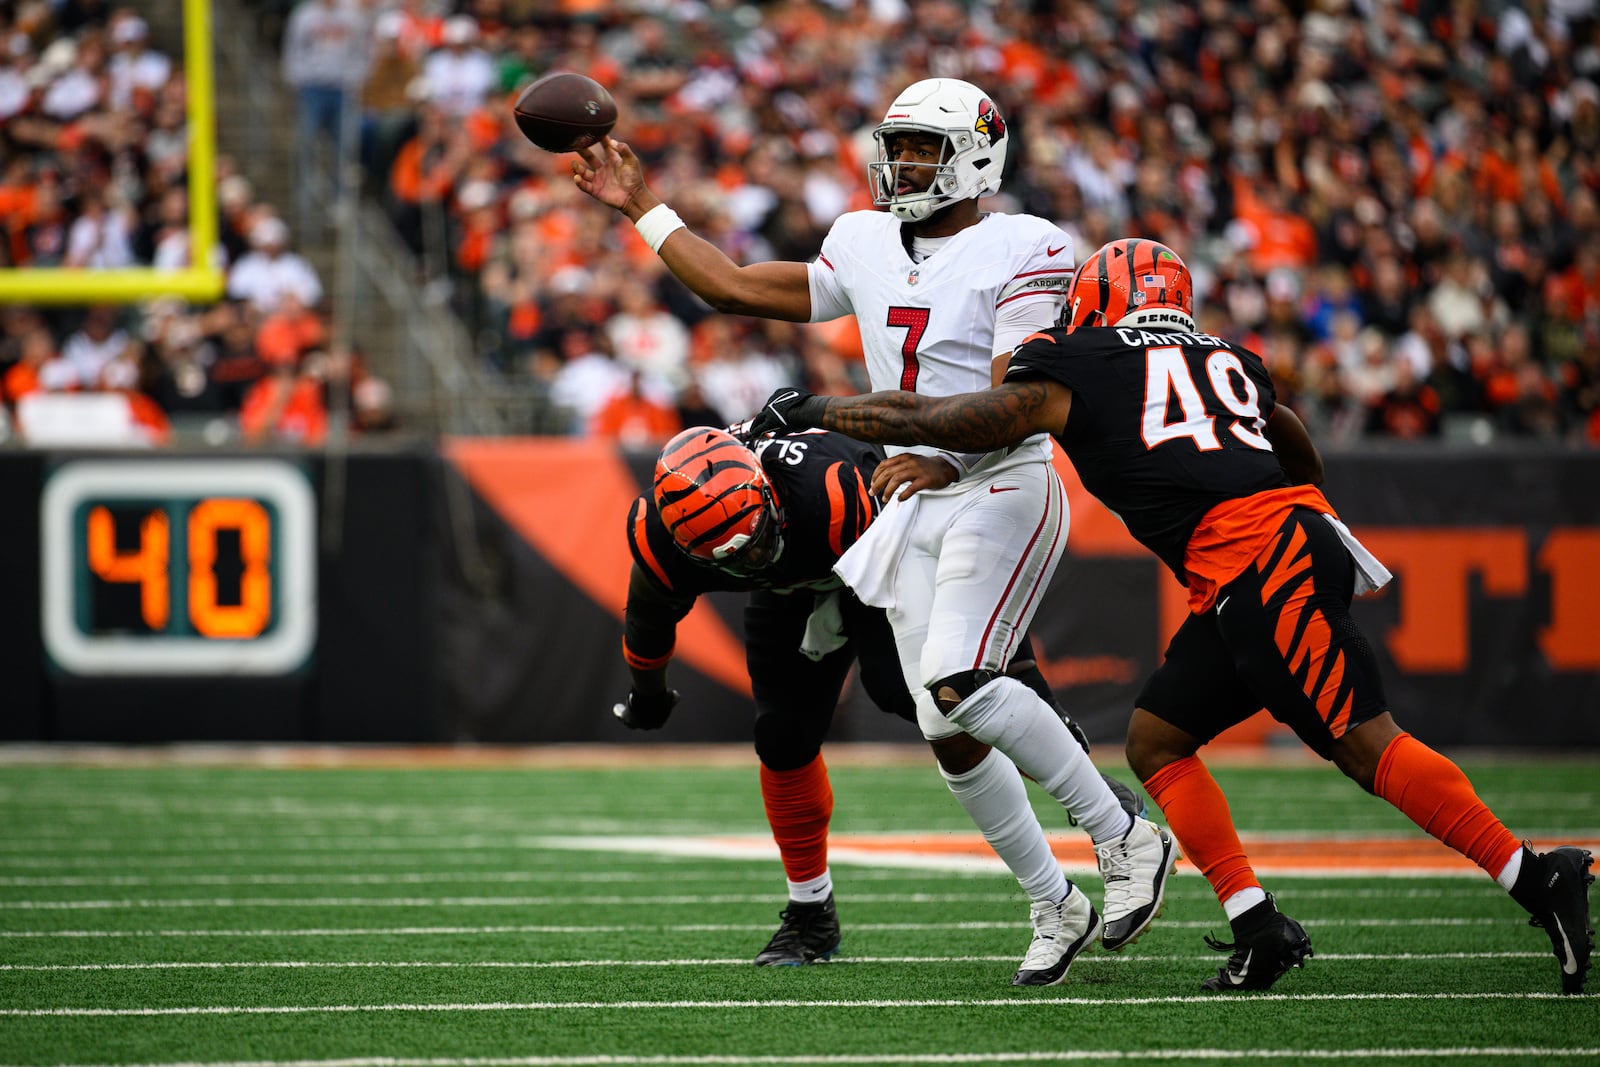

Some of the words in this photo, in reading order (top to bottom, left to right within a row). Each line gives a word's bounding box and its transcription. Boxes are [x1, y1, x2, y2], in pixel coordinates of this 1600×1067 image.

[886, 306, 931, 393] 7
[1140, 345, 1273, 452] 49
[87, 497, 270, 640] 40
